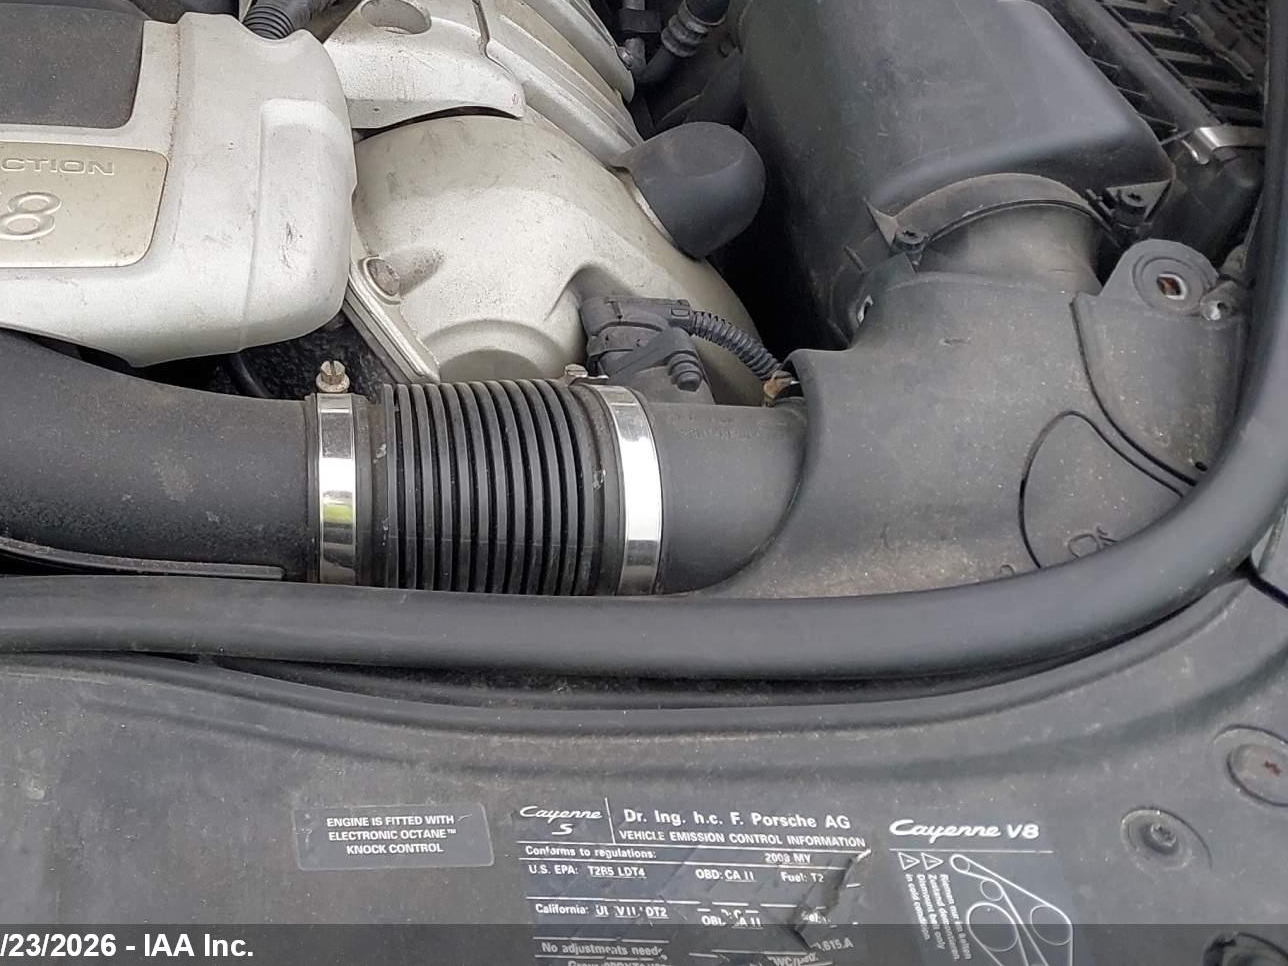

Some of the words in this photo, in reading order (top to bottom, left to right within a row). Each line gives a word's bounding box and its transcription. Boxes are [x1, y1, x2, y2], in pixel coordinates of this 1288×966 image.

[519, 806, 602, 823] Cayenne
[624, 809, 647, 823] Dr.
[655, 810, 686, 826] Ing.
[693, 811, 723, 825] h.c.
[730, 812, 744, 825] F.
[751, 812, 817, 828] Porsche
[825, 815, 851, 829] AG
[326, 817, 369, 827] ENGINE
[372, 817, 382, 826] IS
[385, 816, 422, 826] FITTED
[424, 815, 454, 825] WITH
[552, 823, 574, 835] S
[889, 818, 1000, 843] Cayenne
[1007, 823, 1039, 839] V8
[328, 831, 398, 841] ELECTRONIC
[619, 830, 665, 841] VEHICLE
[670, 831, 725, 843] EMISSION
[729, 833, 782, 844] CONTROL
[787, 835, 865, 847] INFORMATION
[346, 845, 387, 855] KNOCK
[389, 843, 444, 853] CONTROL
[525, 845, 575, 856] Conforms
[579, 847, 591, 857] to
[594, 848, 657, 859] regulations:
[529, 864, 551, 874] U.S.
[554, 865, 578, 875] EPA:
[695, 869, 723, 880] OBD:
[781, 872, 807, 883] Fuel:
[535, 903, 588, 914] California:
[542, 942, 558, 953] No
